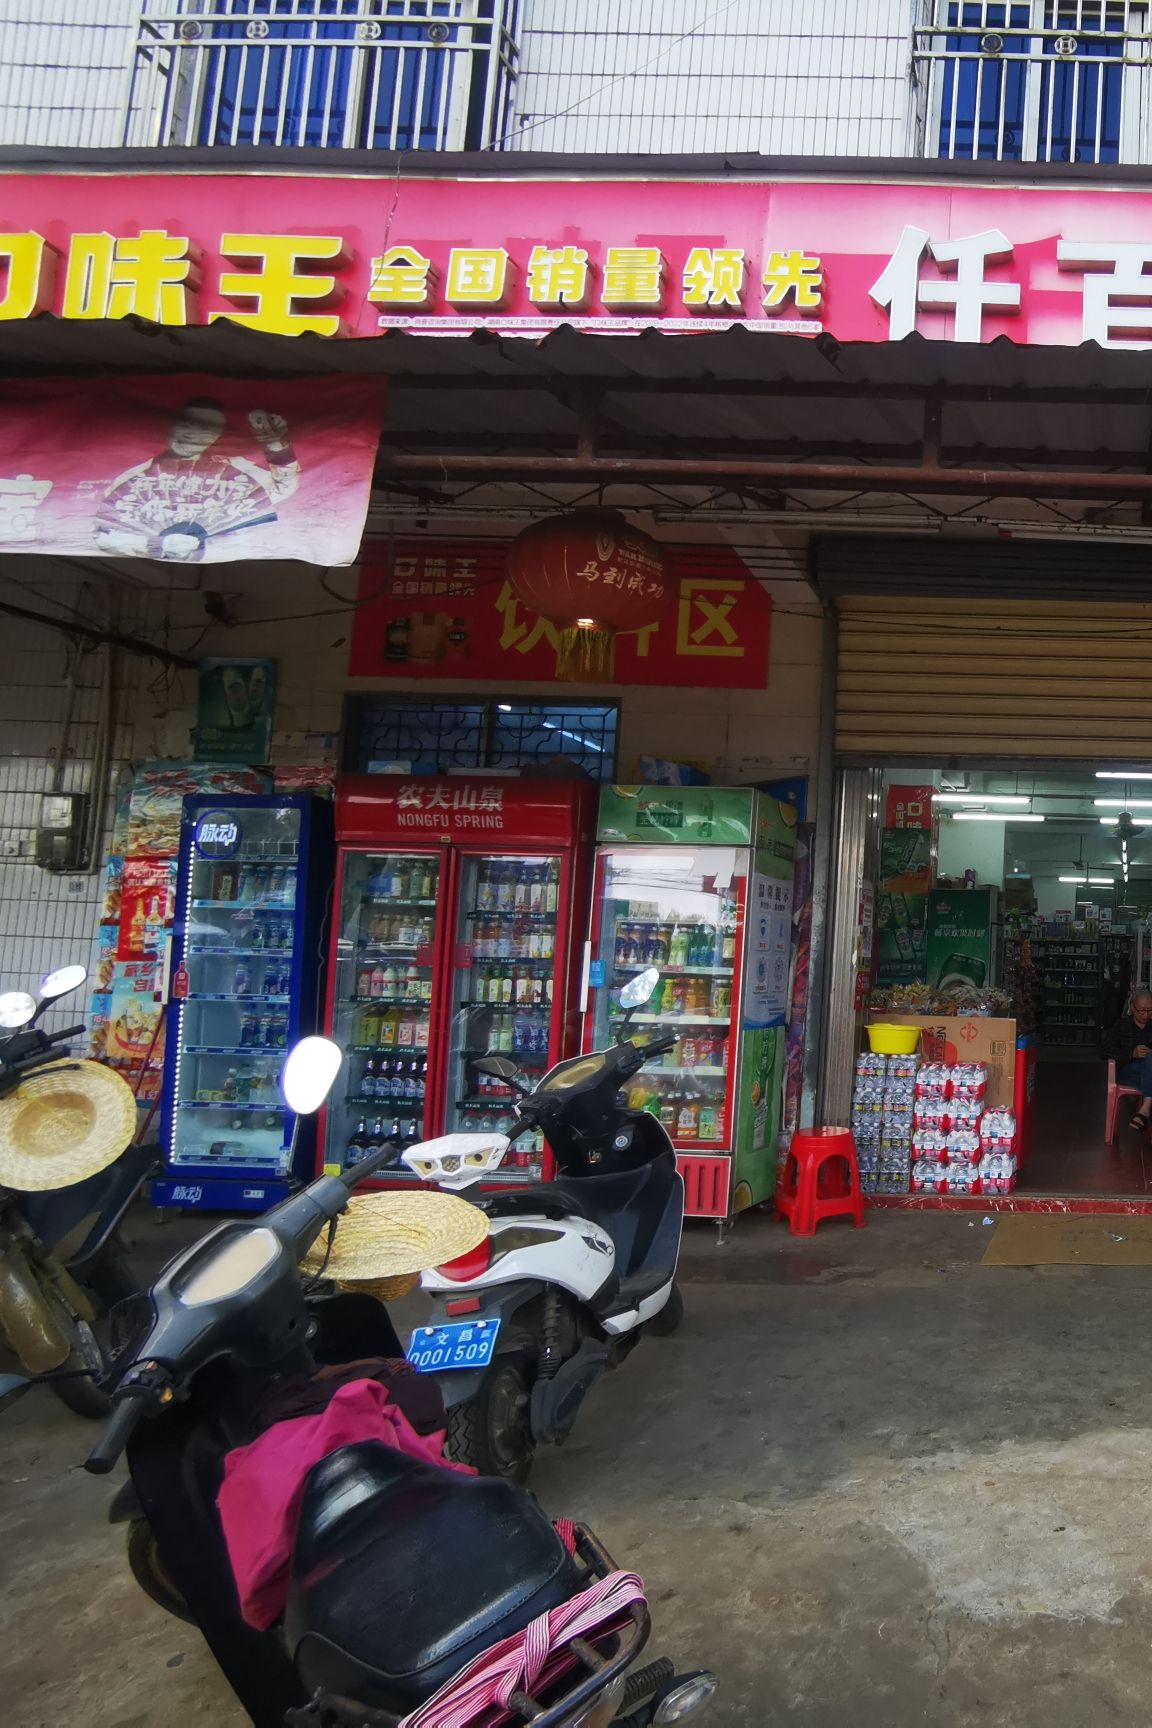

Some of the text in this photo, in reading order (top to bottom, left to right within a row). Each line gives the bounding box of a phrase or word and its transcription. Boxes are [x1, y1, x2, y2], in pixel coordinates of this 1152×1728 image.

[369, 245, 825, 309] 全国销量领先
[394, 558, 477, 578] 口味王
[576, 560, 664, 600] 马到成功
[396, 784, 504, 811] 农夫山泉
[397, 814, 504, 829] NONGFU SPRING
[198, 823, 238, 847] 脉动
[171, 1185, 204, 1204] 脉动
[435, 1329, 472, 1347] 文 昌
